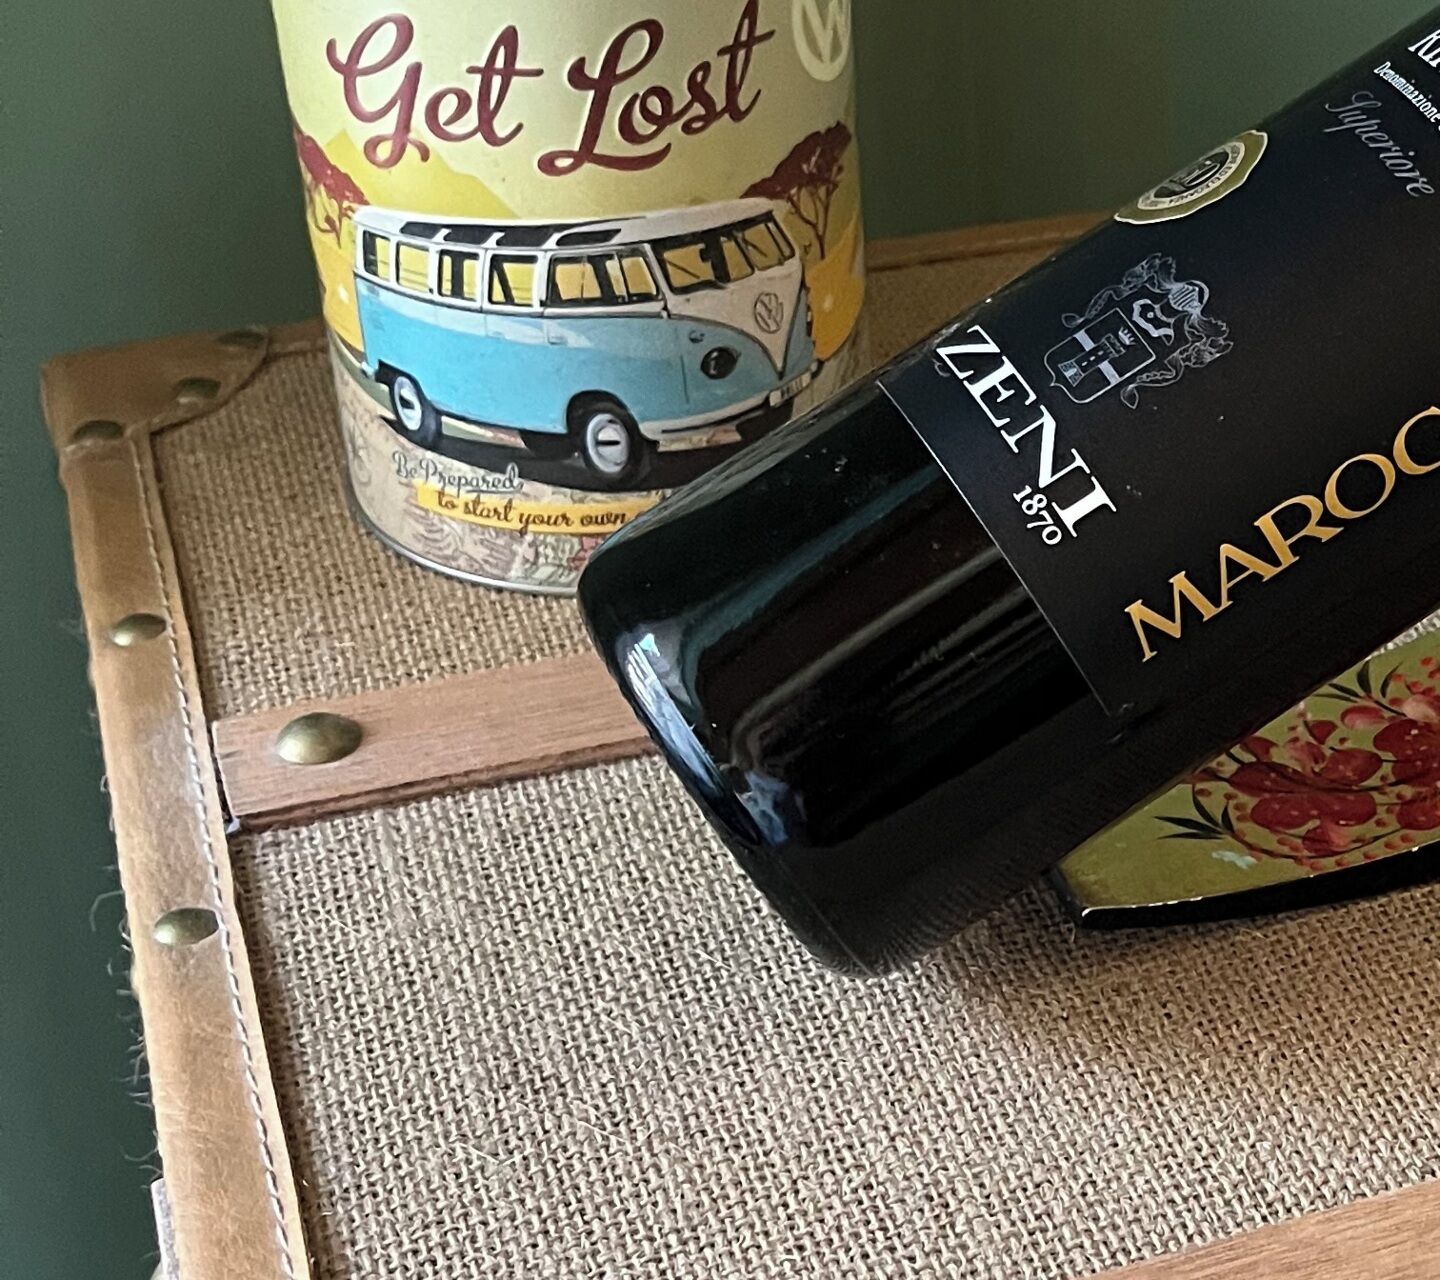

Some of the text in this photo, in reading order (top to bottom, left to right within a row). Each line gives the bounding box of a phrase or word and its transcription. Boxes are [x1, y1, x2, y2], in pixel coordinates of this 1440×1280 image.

[326, 13, 544, 169] Get
[1323, 90, 1436, 198] Superiore
[392, 450, 417, 478] Be
[936, 324, 1117, 538] ZENI
[436, 489, 456, 510] to
[463, 497, 514, 524] start
[518, 510, 575, 537] your
[579, 510, 628, 526] own
[1012, 485, 1063, 546] 1870
